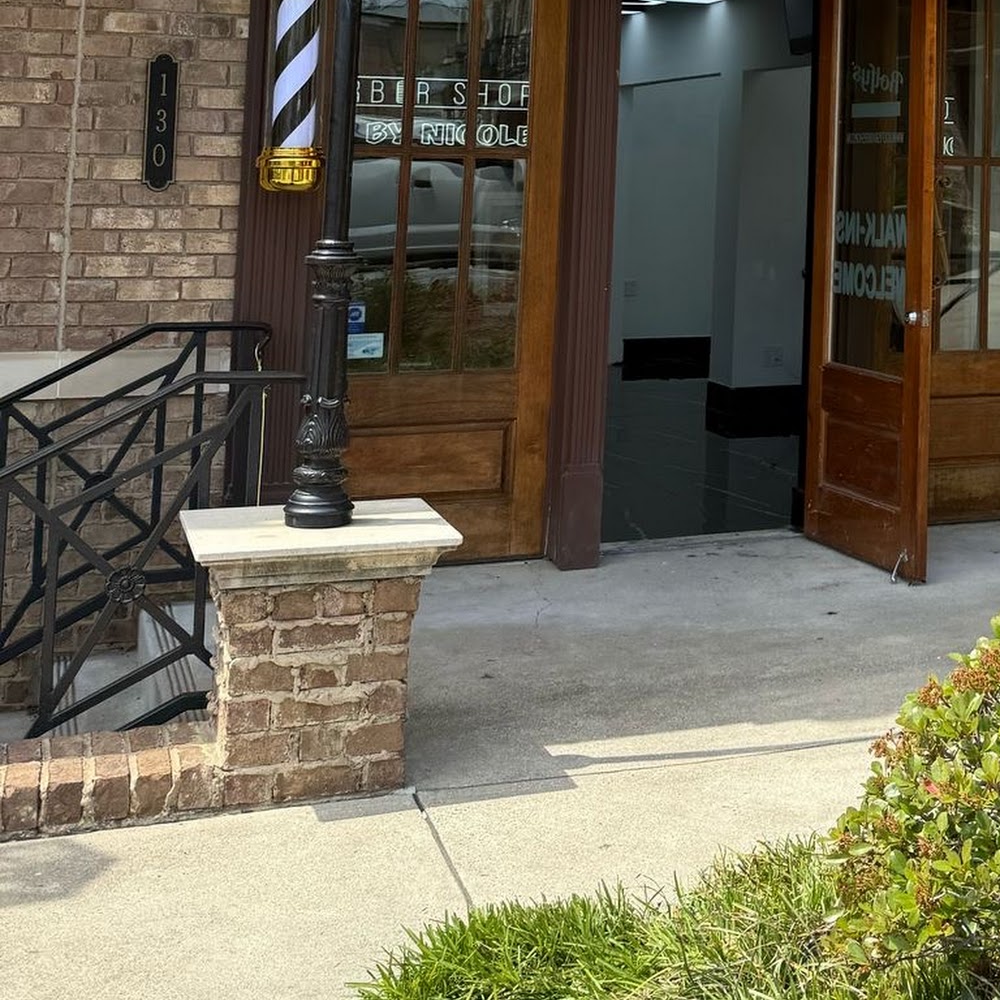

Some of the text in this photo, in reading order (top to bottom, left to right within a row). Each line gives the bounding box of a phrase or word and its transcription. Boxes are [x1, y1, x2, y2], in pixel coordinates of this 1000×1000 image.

[152, 73, 167, 167] 130
[366, 122, 528, 147] BY NICOLE
